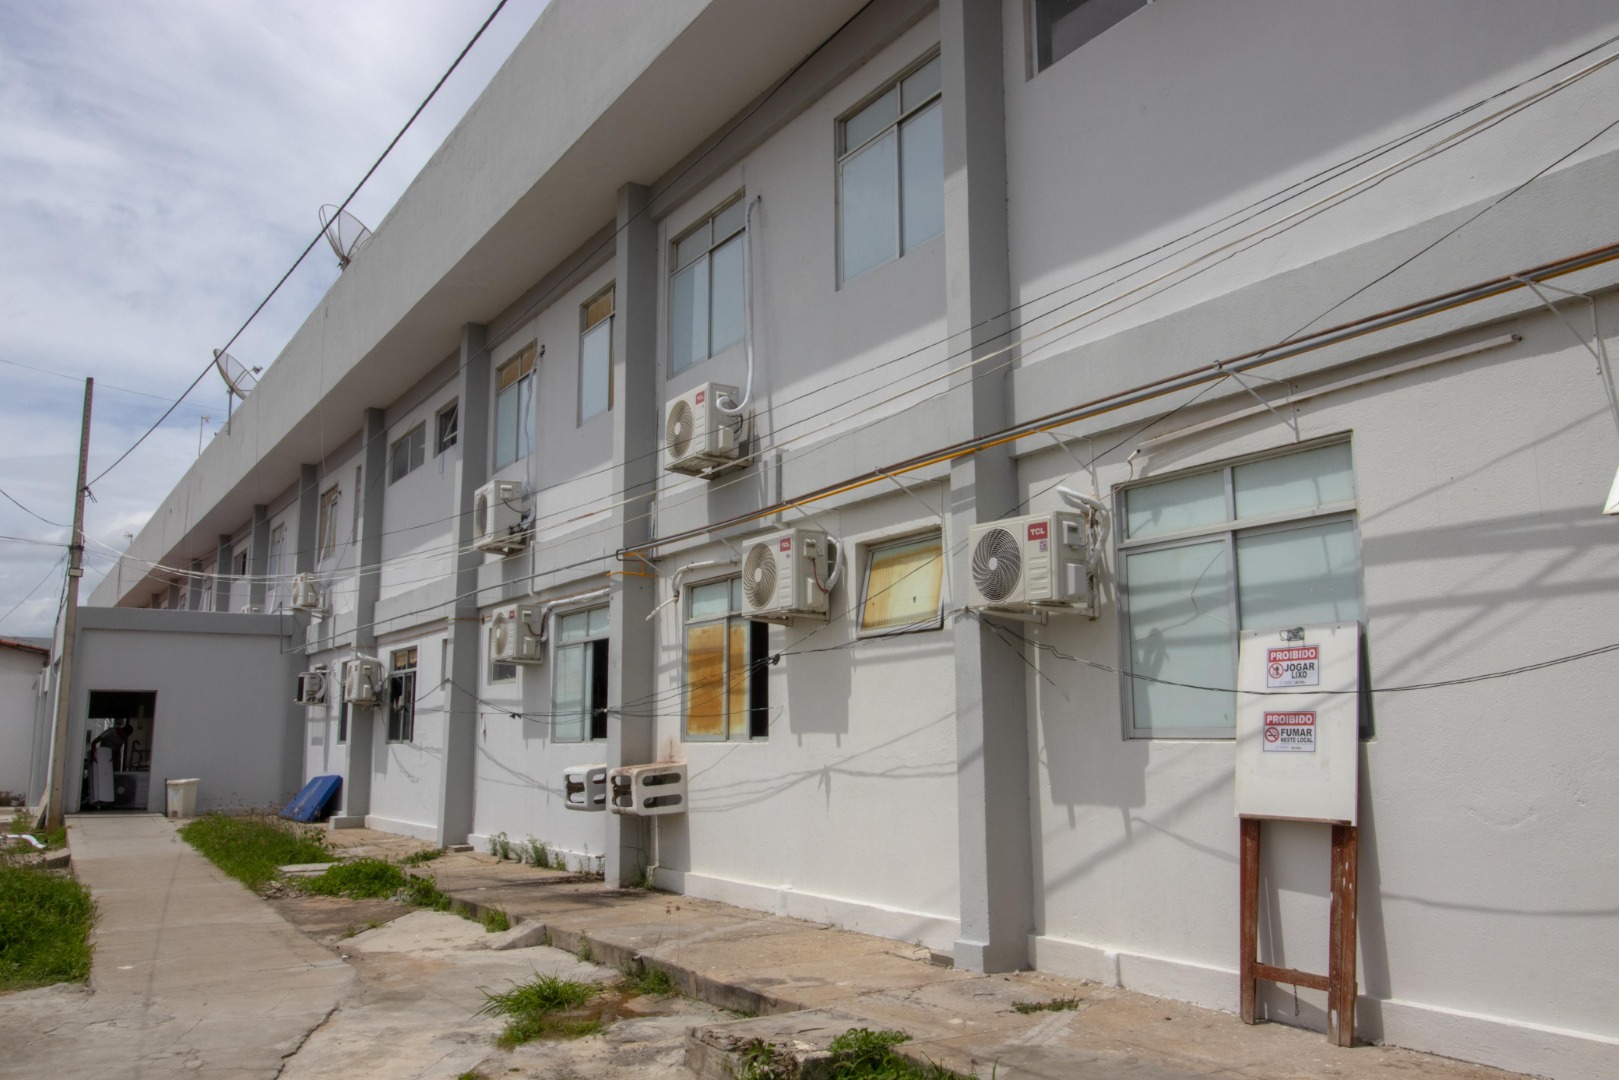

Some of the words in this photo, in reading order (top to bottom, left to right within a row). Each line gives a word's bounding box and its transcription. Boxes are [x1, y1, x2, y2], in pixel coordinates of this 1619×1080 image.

[1030, 527, 1045, 535] TCL
[1270, 649, 1316, 660] PROIBIDO
[1284, 662, 1315, 672] JOGAR
[1266, 714, 1313, 724] PROIBIDO
[1280, 728, 1312, 737] FUMAR
